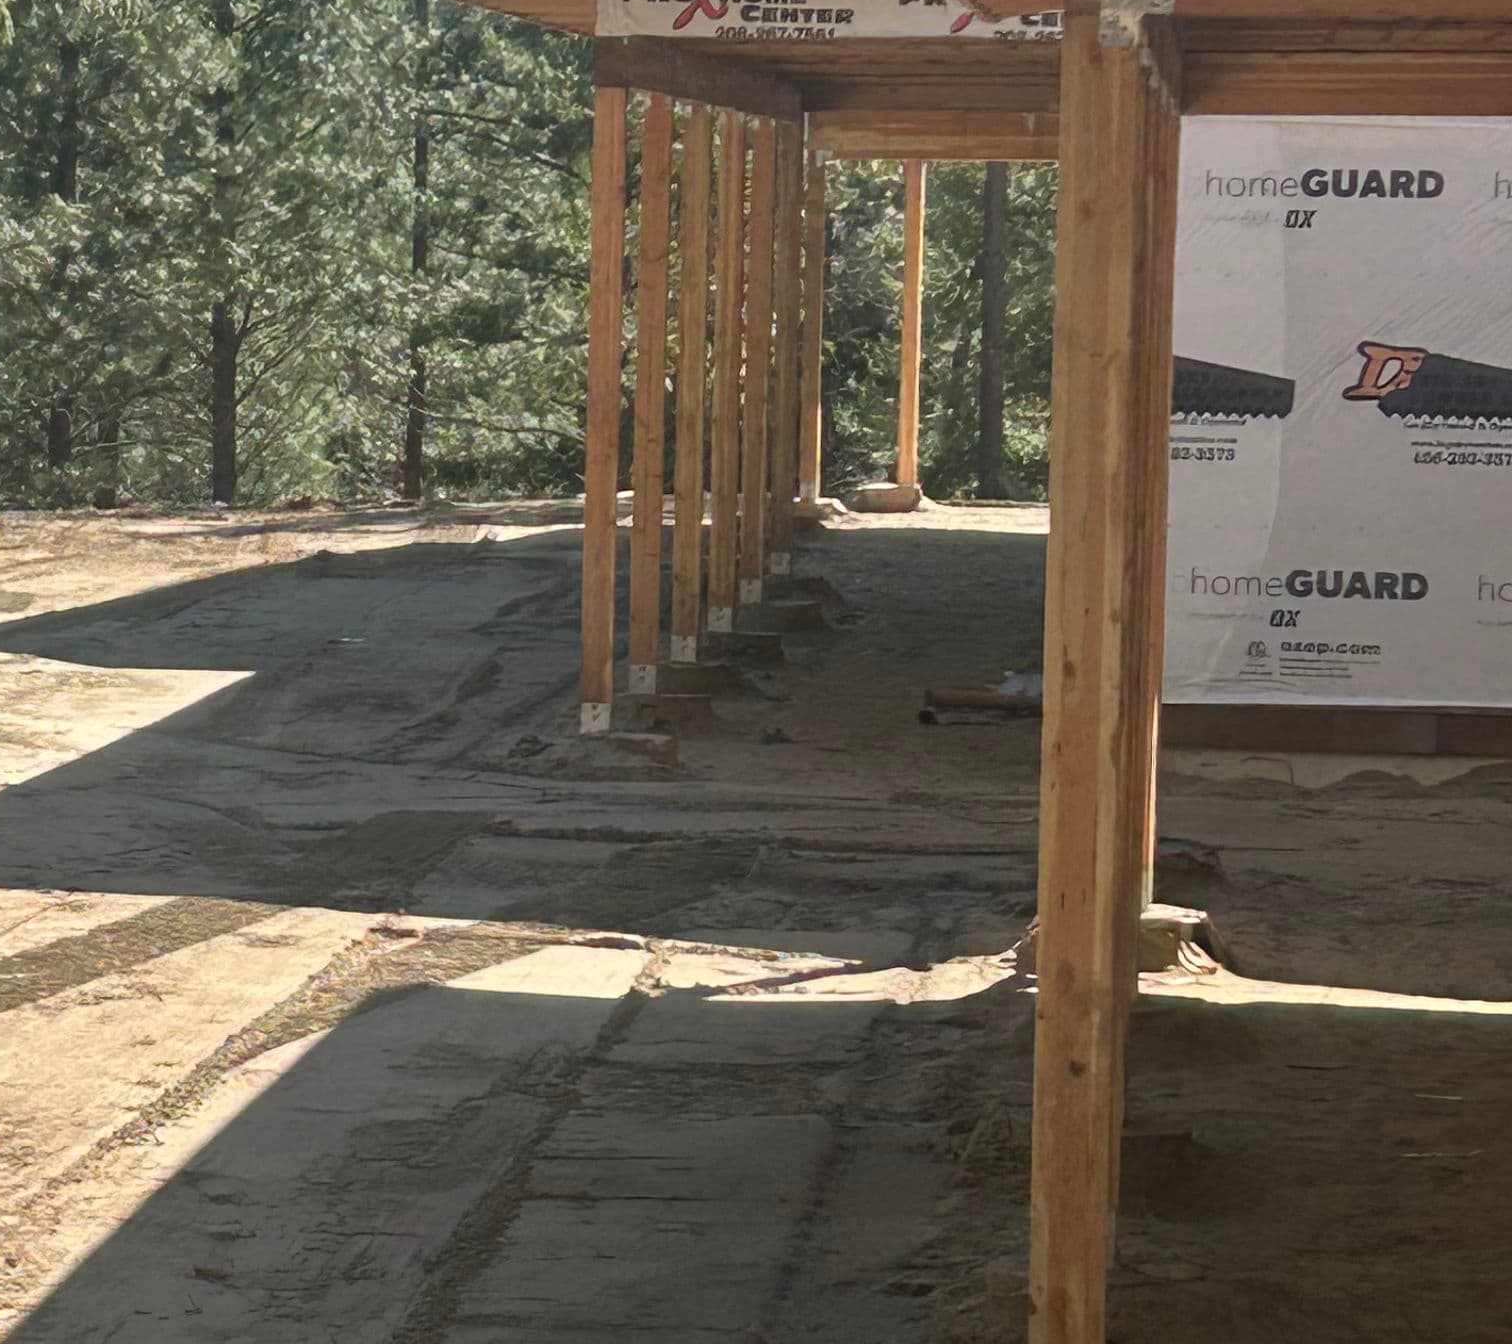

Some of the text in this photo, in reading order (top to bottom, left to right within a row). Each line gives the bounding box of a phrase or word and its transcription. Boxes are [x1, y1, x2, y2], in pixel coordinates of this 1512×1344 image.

[740, 4, 855, 25] CENTER
[1205, 168, 1445, 199] homeGUARD
[1190, 567, 1429, 600] homeGUARD
